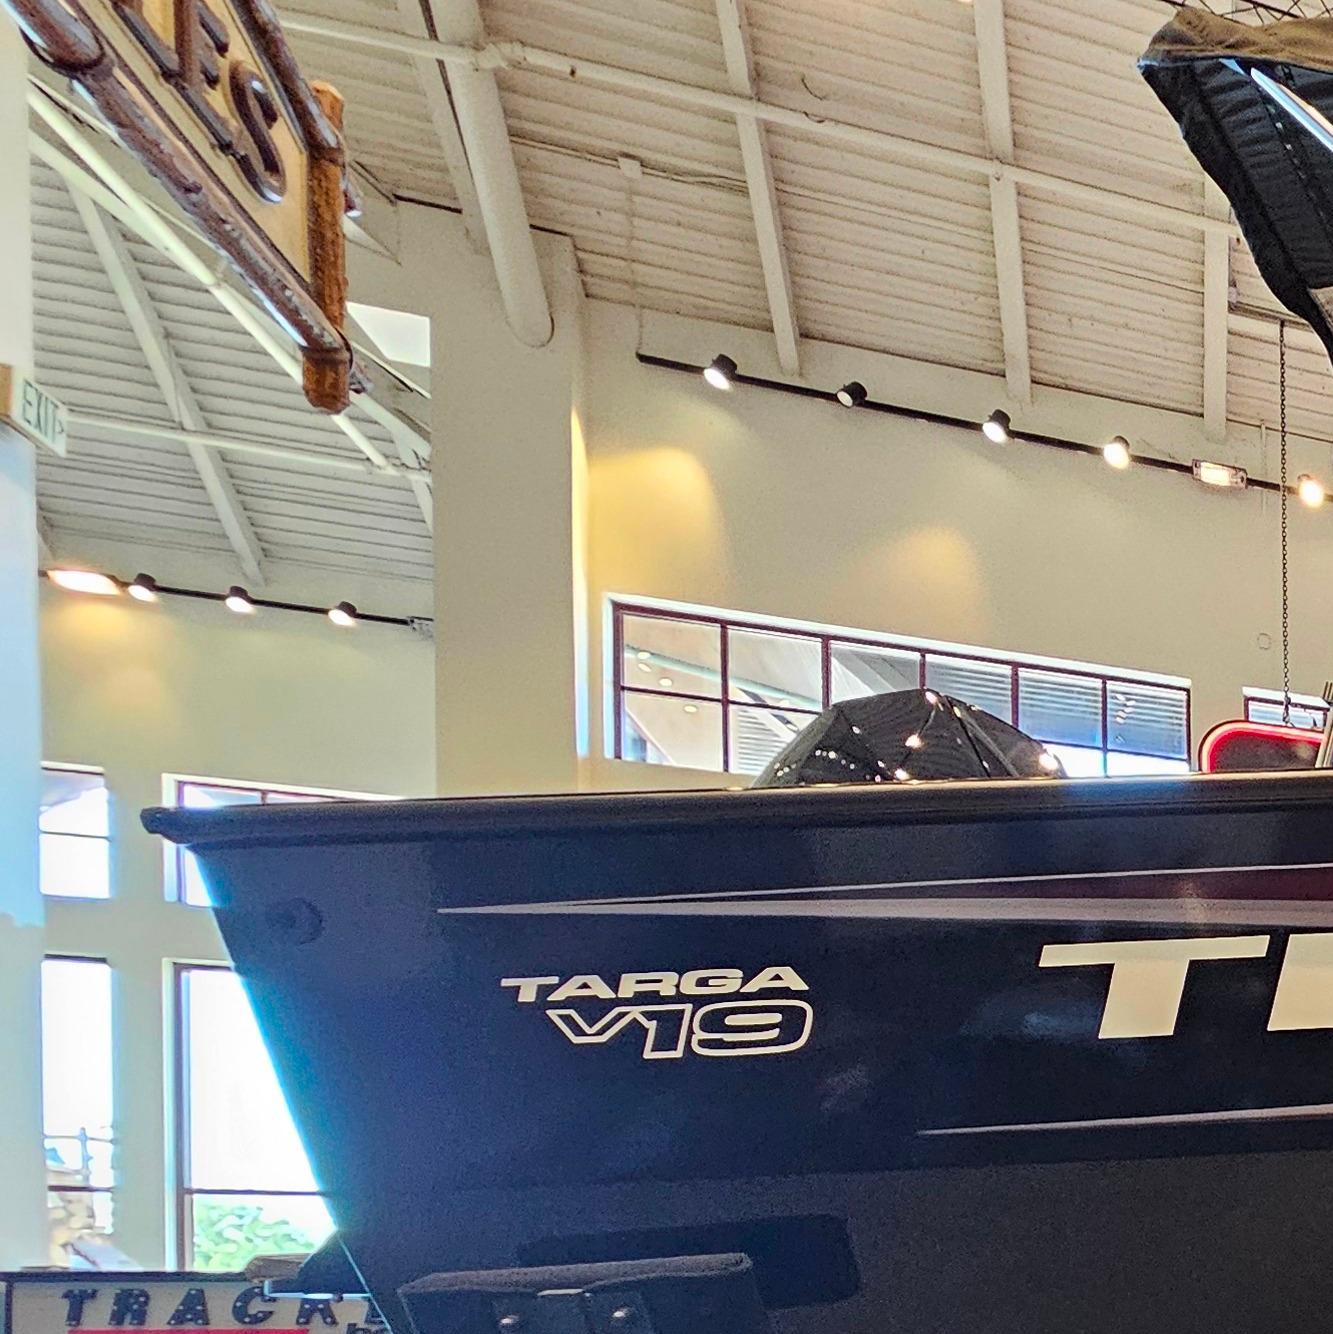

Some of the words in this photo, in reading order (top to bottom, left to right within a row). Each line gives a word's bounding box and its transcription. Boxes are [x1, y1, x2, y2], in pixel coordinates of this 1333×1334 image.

[22, 379, 60, 443] EXIT
[500, 966, 810, 1003] TARGA
[545, 999, 814, 1059] V19
